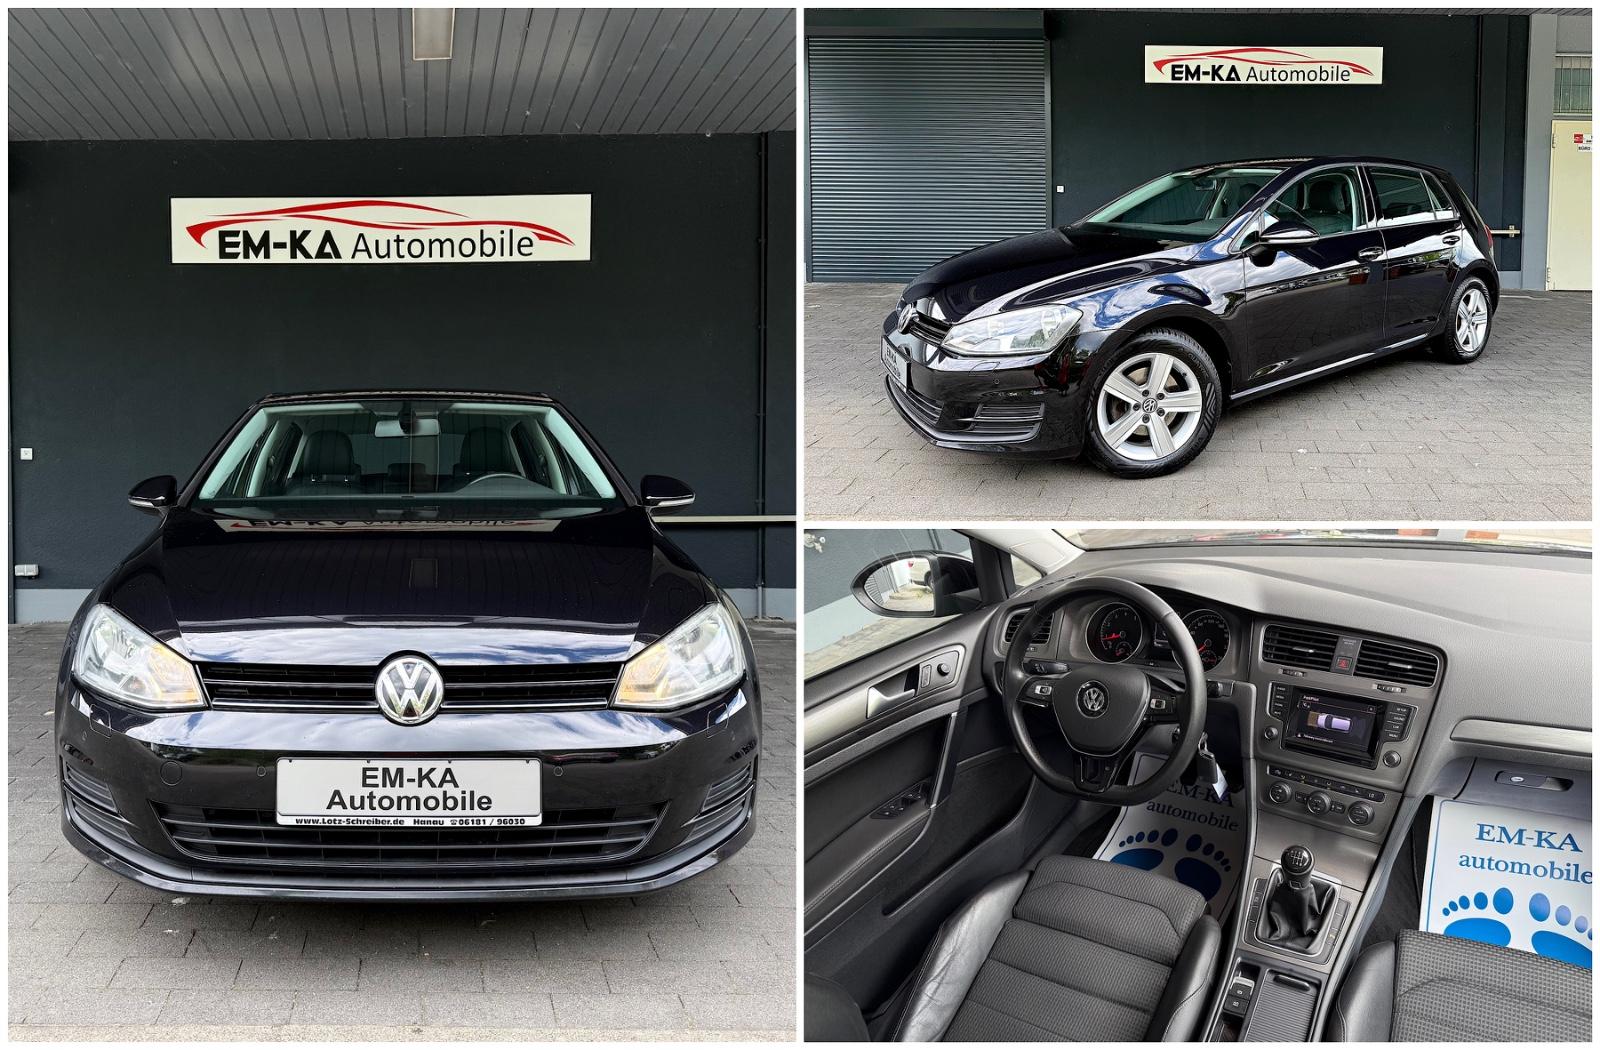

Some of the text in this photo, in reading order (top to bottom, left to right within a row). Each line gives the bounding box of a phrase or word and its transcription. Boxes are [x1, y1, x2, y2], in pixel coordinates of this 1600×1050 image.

[1171, 64, 1351, 82] EM-KA Automobile
[218, 228, 534, 260] EM-KA Automobile
[362, 767, 459, 789] EM-KA
[326, 789, 493, 811] Automobile
[295, 817, 405, 826] www.Lotz-Schreiber.de
[413, 818, 445, 826] Hanau
[459, 818, 487, 826] 06181
[496, 818, 526, 826] 96030
[1146, 800, 1240, 832] automobile
[1475, 823, 1584, 853] EM-KA
[1459, 854, 1592, 885] automobile
